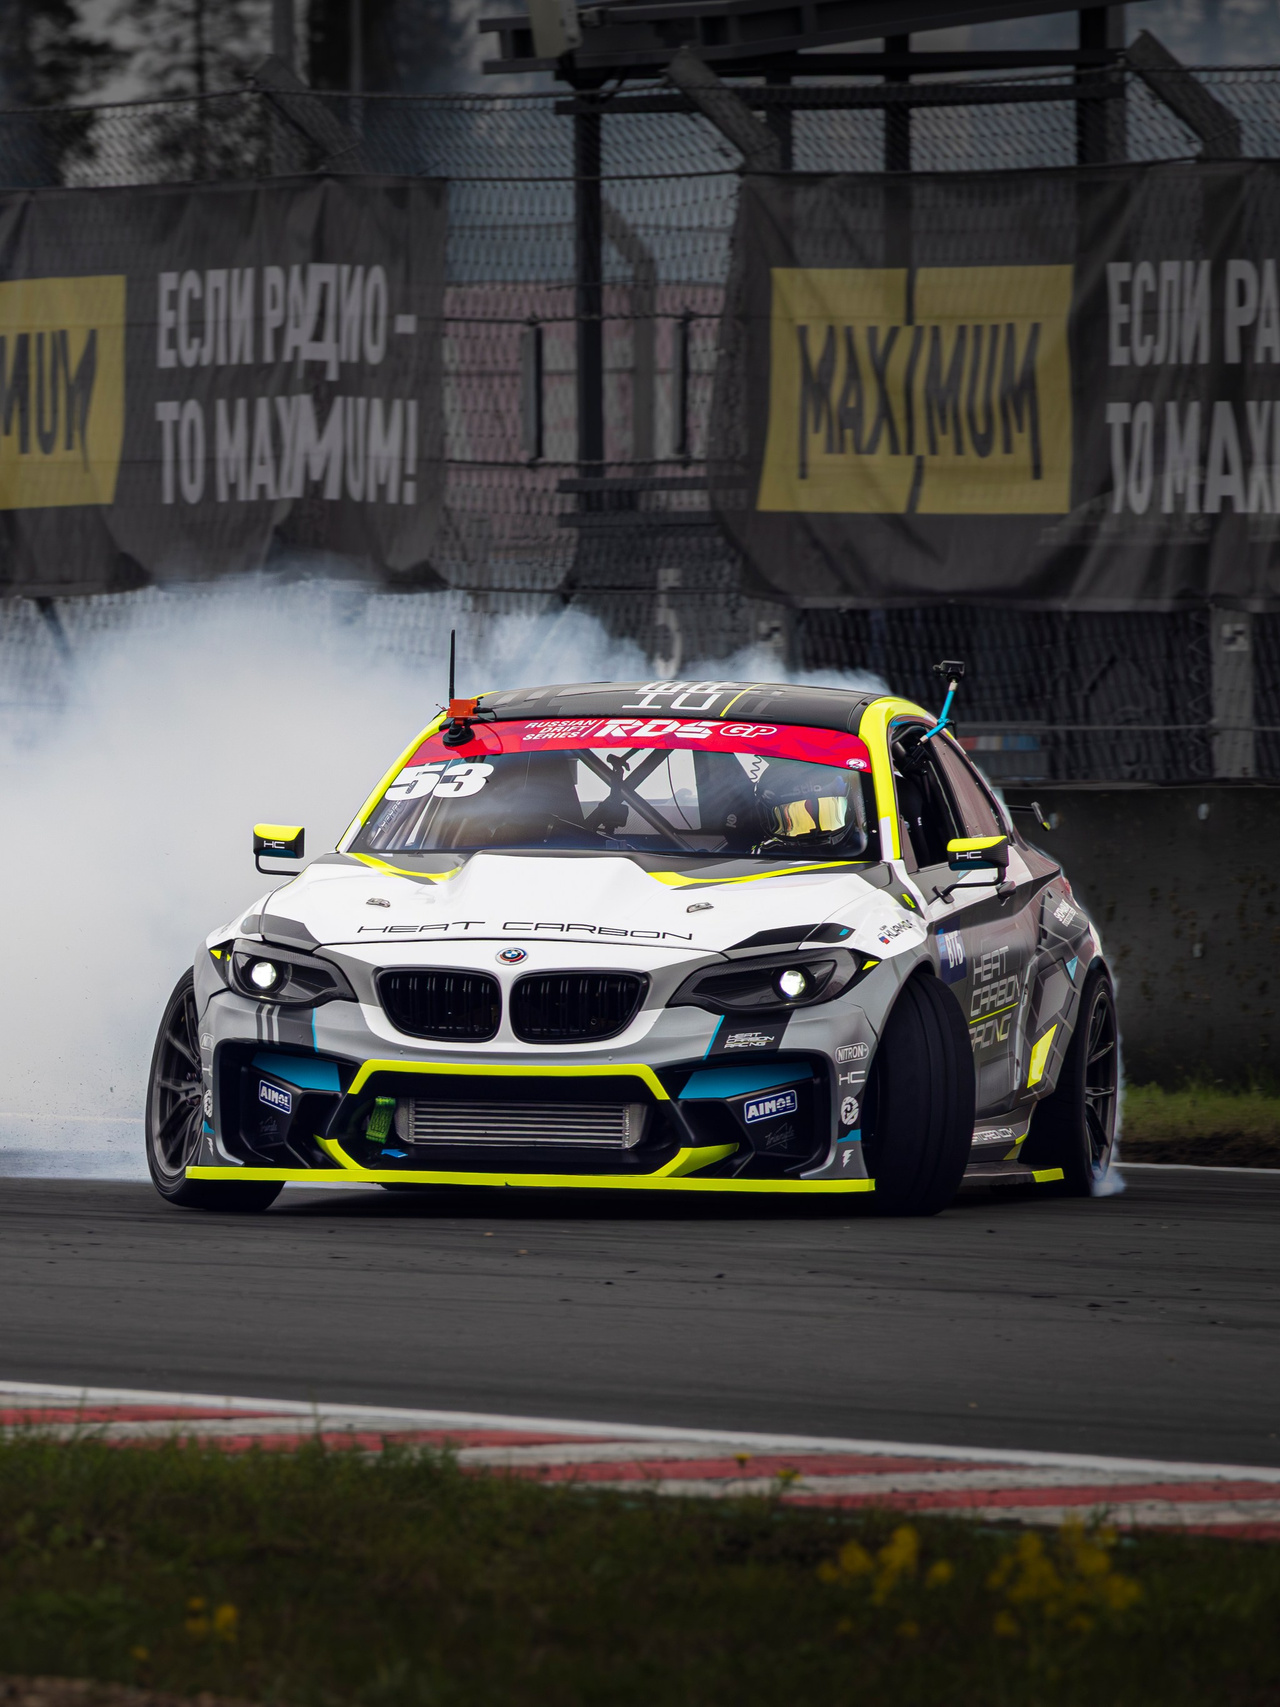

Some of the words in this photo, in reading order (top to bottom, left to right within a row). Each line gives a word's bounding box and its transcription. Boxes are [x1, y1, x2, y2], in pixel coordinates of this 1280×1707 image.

[156, 267, 254, 368] ЕСЛИ
[263, 262, 388, 381] РАДИО
[1106, 260, 1211, 367] ЕСЛИ
[797, 322, 1043, 481] MAXIMUM
[156, 398, 204, 505] ТО
[1106, 400, 1155, 515] ТО
[522, 731, 582, 741] SERIES
[524, 719, 598, 729] RUSSIAN
[593, 719, 725, 739] RDS
[720, 723, 778, 738] GP
[541, 725, 589, 734] DRIFT
[384, 763, 495, 802] 53
[263, 840, 285, 849] HC
[955, 850, 983, 861] HC
[357, 921, 487, 934] HEAT
[501, 921, 693, 941] CARBON
[944, 930, 964, 969] ВТБ
[972, 945, 1010, 986] HEAT
[726, 1036, 775, 1044] CARBON
[727, 1032, 762, 1040] HEAT
[838, 1045, 864, 1059] NITRON
[838, 1070, 866, 1086] HC
[260, 1085, 290, 1107] AIMOL
[747, 1096, 795, 1119] AIMOL
